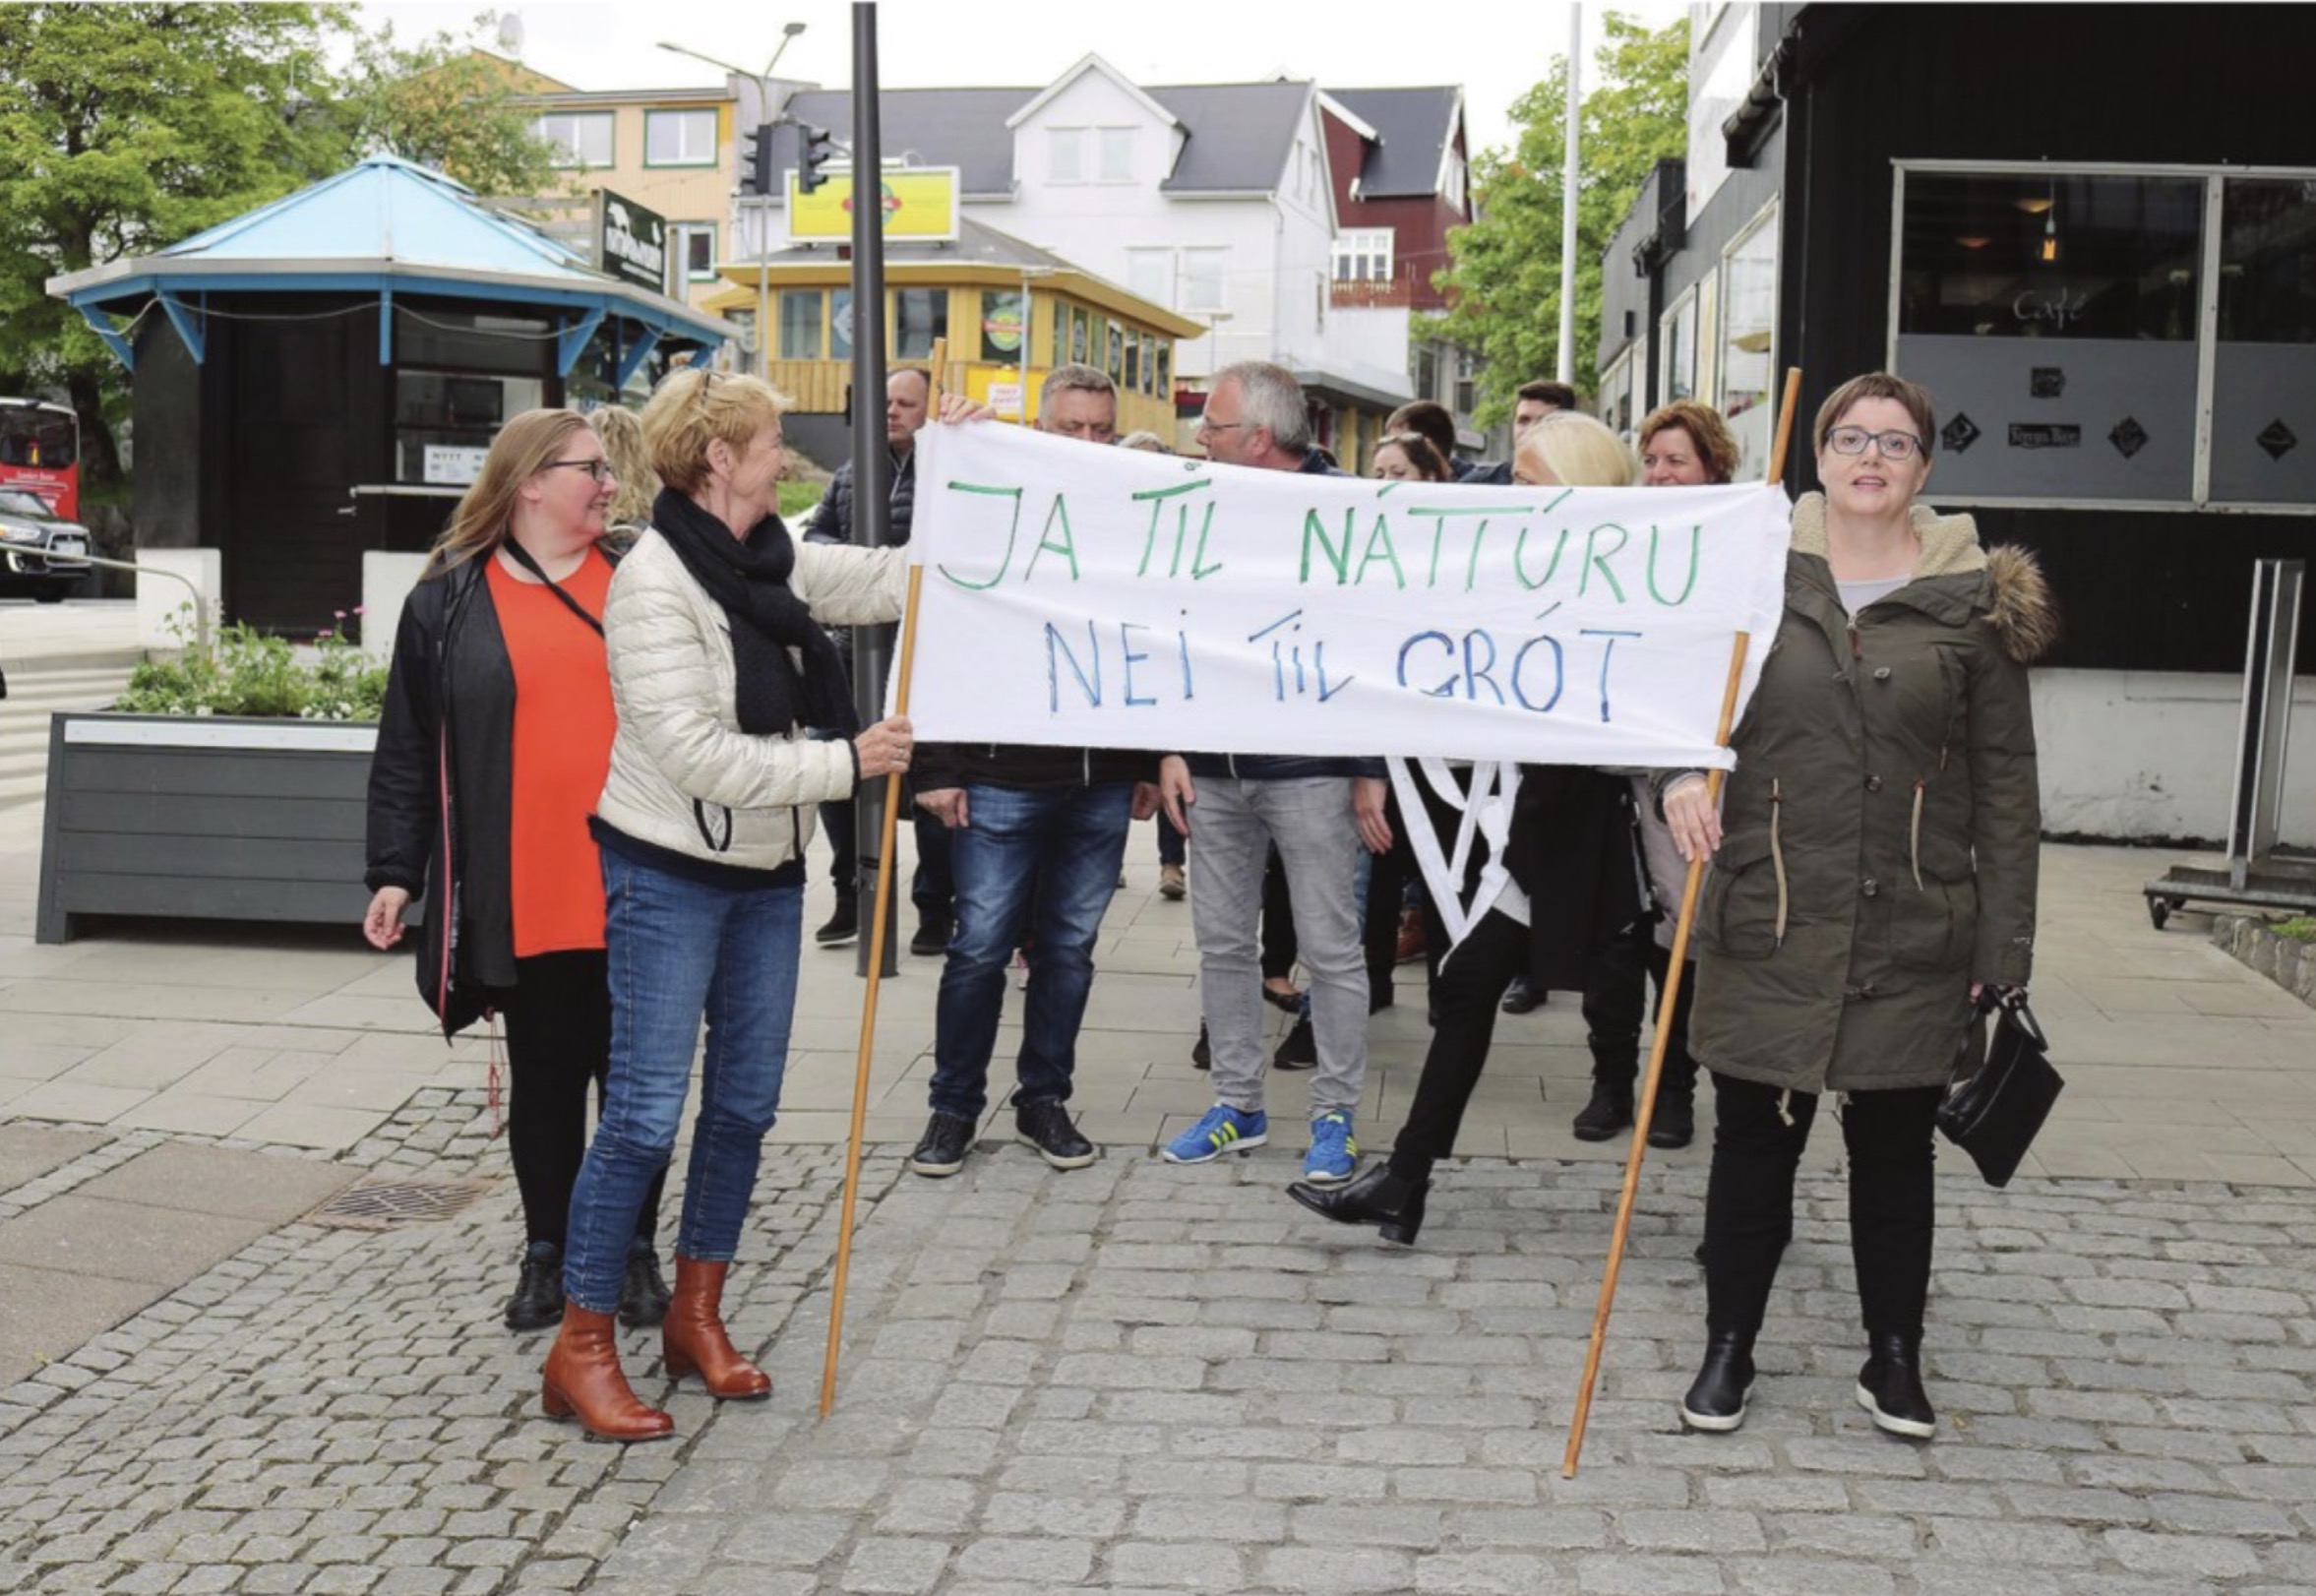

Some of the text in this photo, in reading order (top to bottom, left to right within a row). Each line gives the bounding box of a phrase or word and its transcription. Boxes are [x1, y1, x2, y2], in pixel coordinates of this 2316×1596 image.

[2013, 286, 2088, 330] Café
[938, 480, 1080, 590] JA
[1300, 483, 1702, 606] NÁTTÚRU
[1396, 601, 1643, 723] GRÓT
